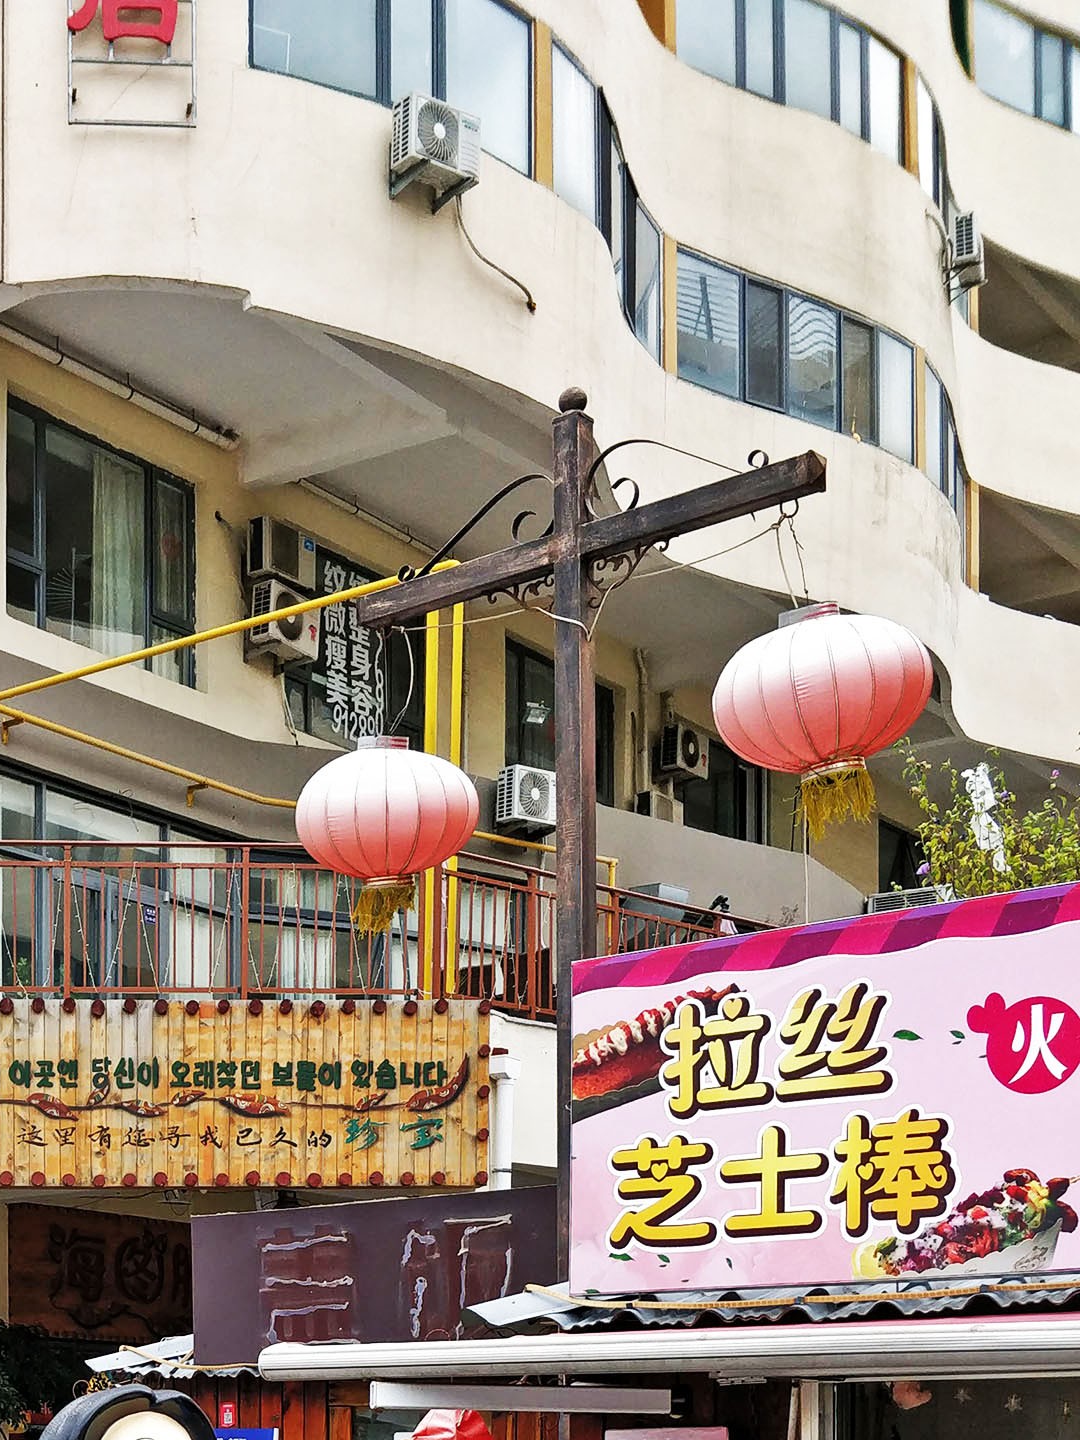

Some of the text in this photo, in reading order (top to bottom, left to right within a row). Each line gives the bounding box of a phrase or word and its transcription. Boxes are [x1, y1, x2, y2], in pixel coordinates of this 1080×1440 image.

[663, 980, 894, 1119] 拉丝
[1008, 1003, 1067, 1085] 火
[610, 1108, 951, 1248] 芝士棒
